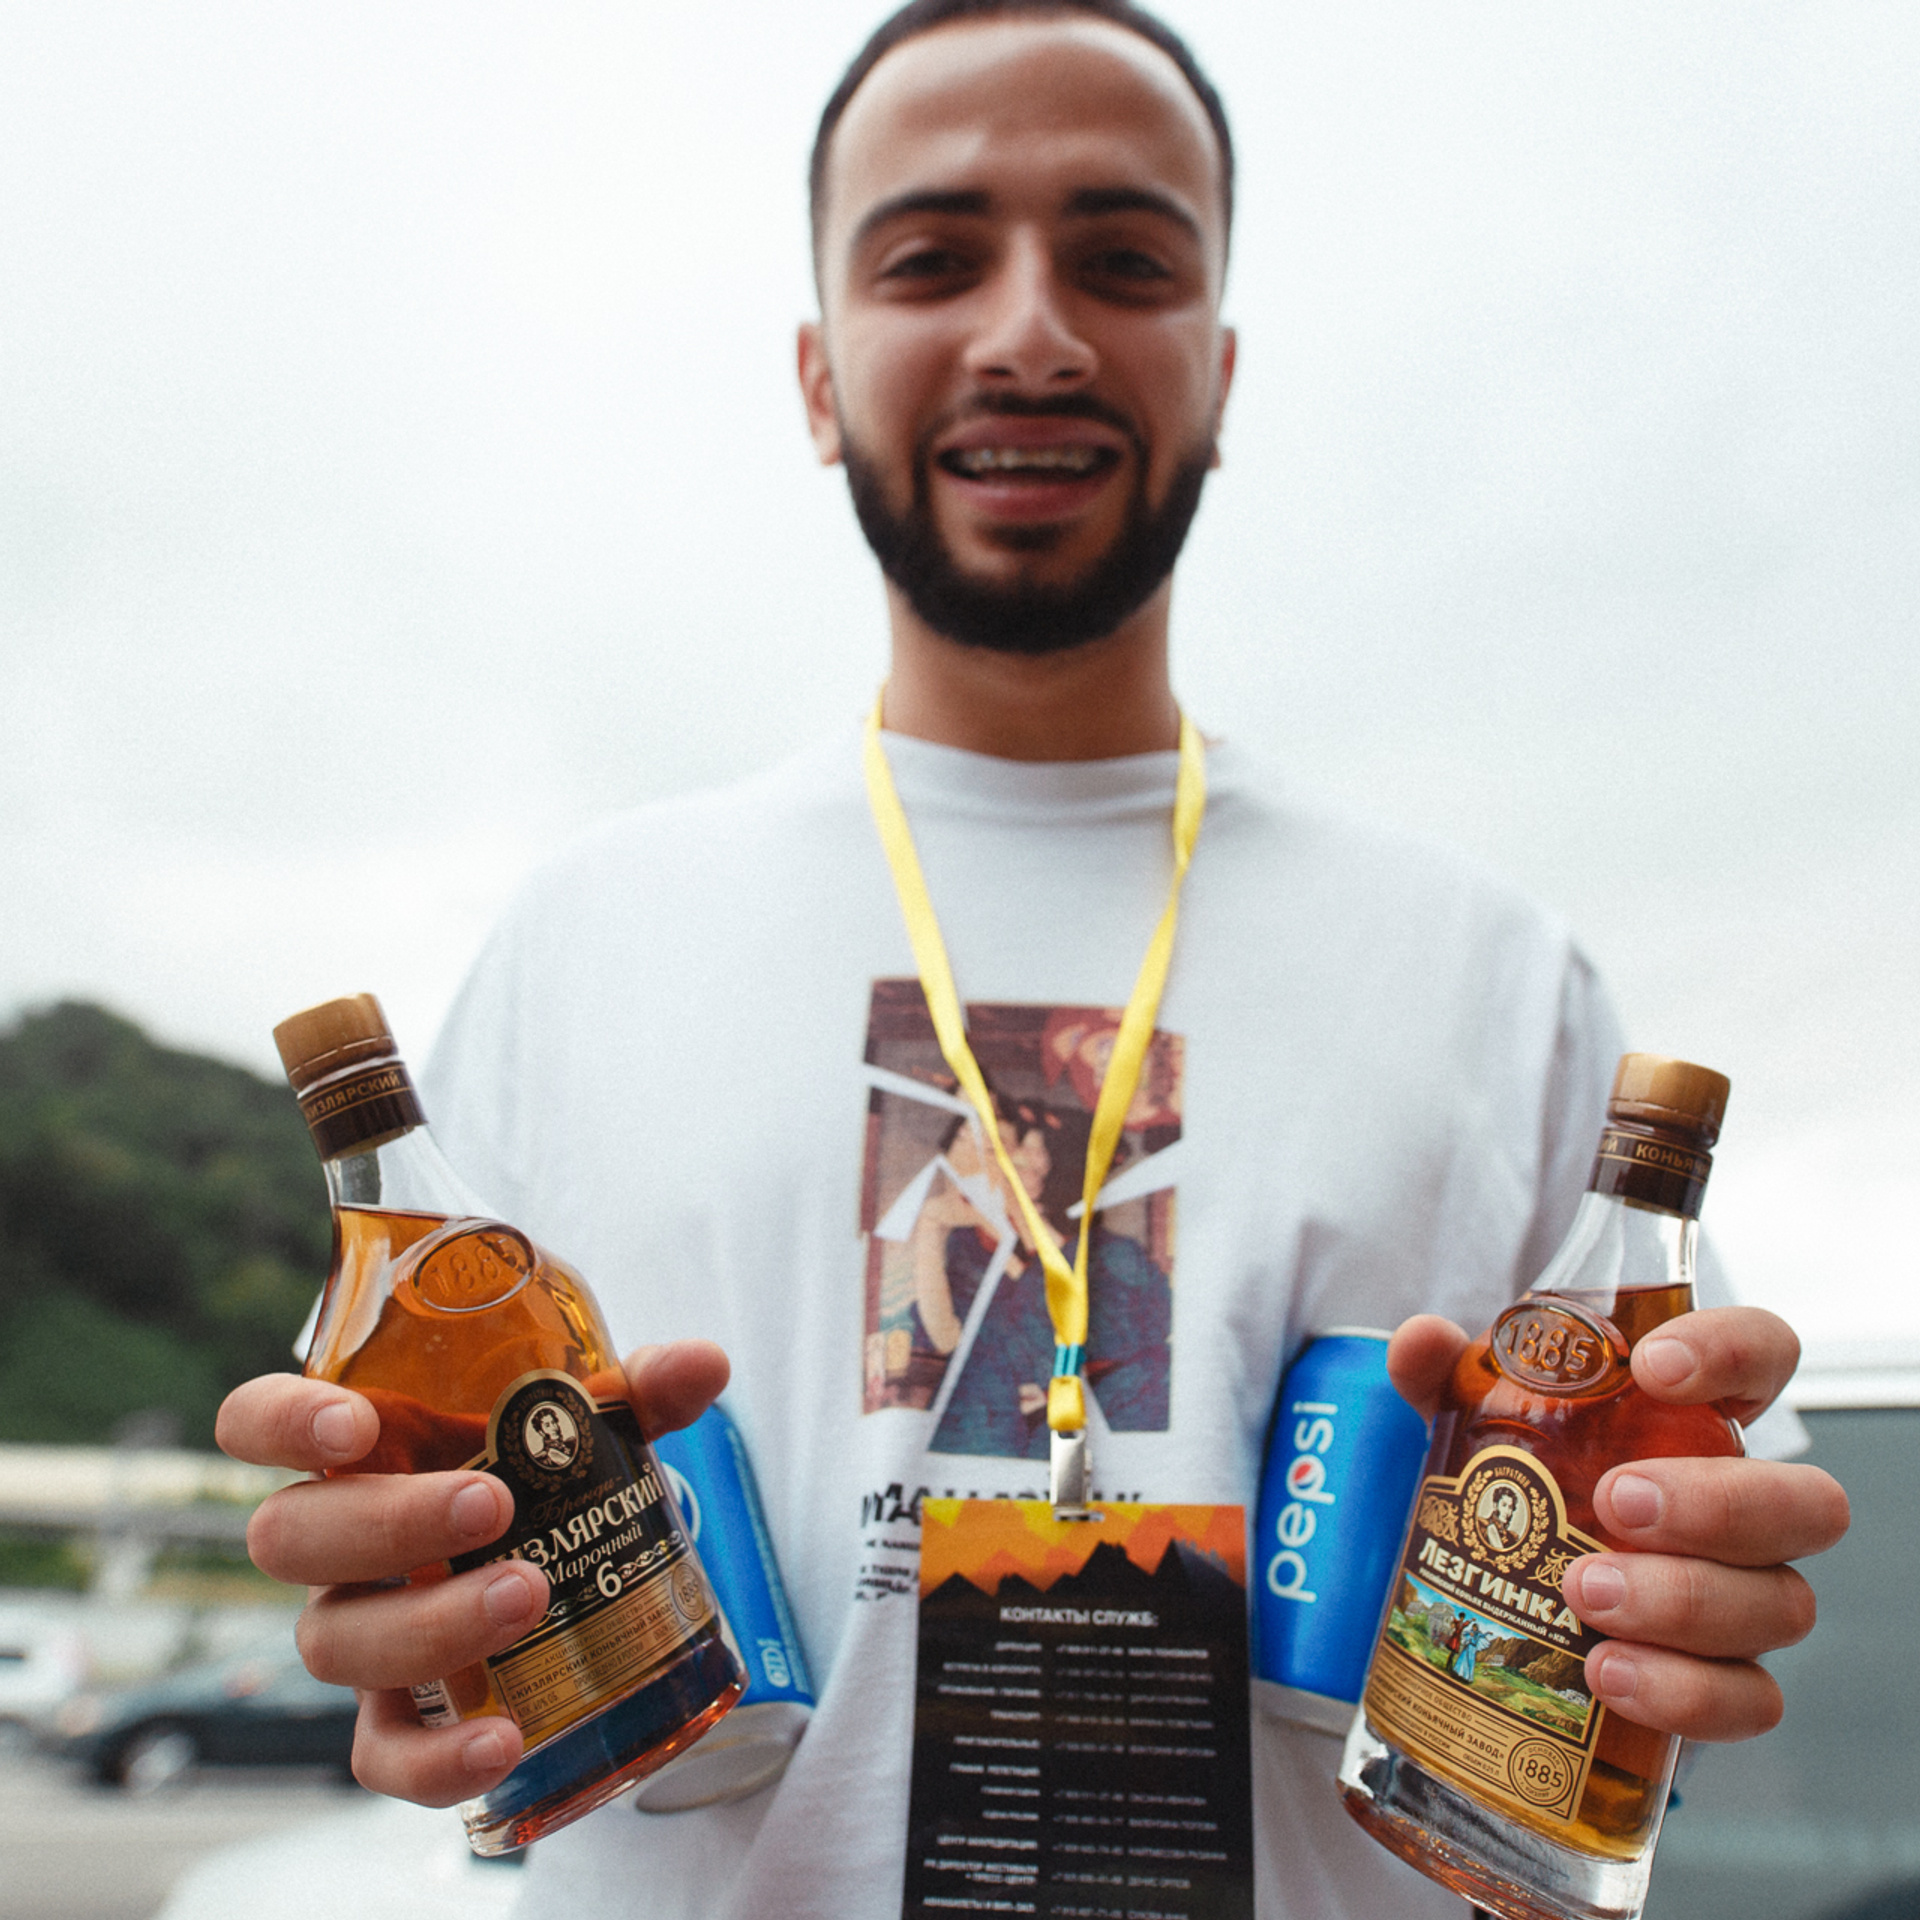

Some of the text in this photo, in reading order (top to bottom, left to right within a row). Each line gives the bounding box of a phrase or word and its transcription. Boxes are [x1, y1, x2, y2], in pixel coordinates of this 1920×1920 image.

[1506, 1319, 1595, 1374] 1885
[1266, 1400, 1339, 1604] pepsi
[596, 1561, 622, 1598] 6
[1418, 1537, 1582, 1636] ЛЕЗГИНКА
[1518, 1757, 1564, 1788] 1885
